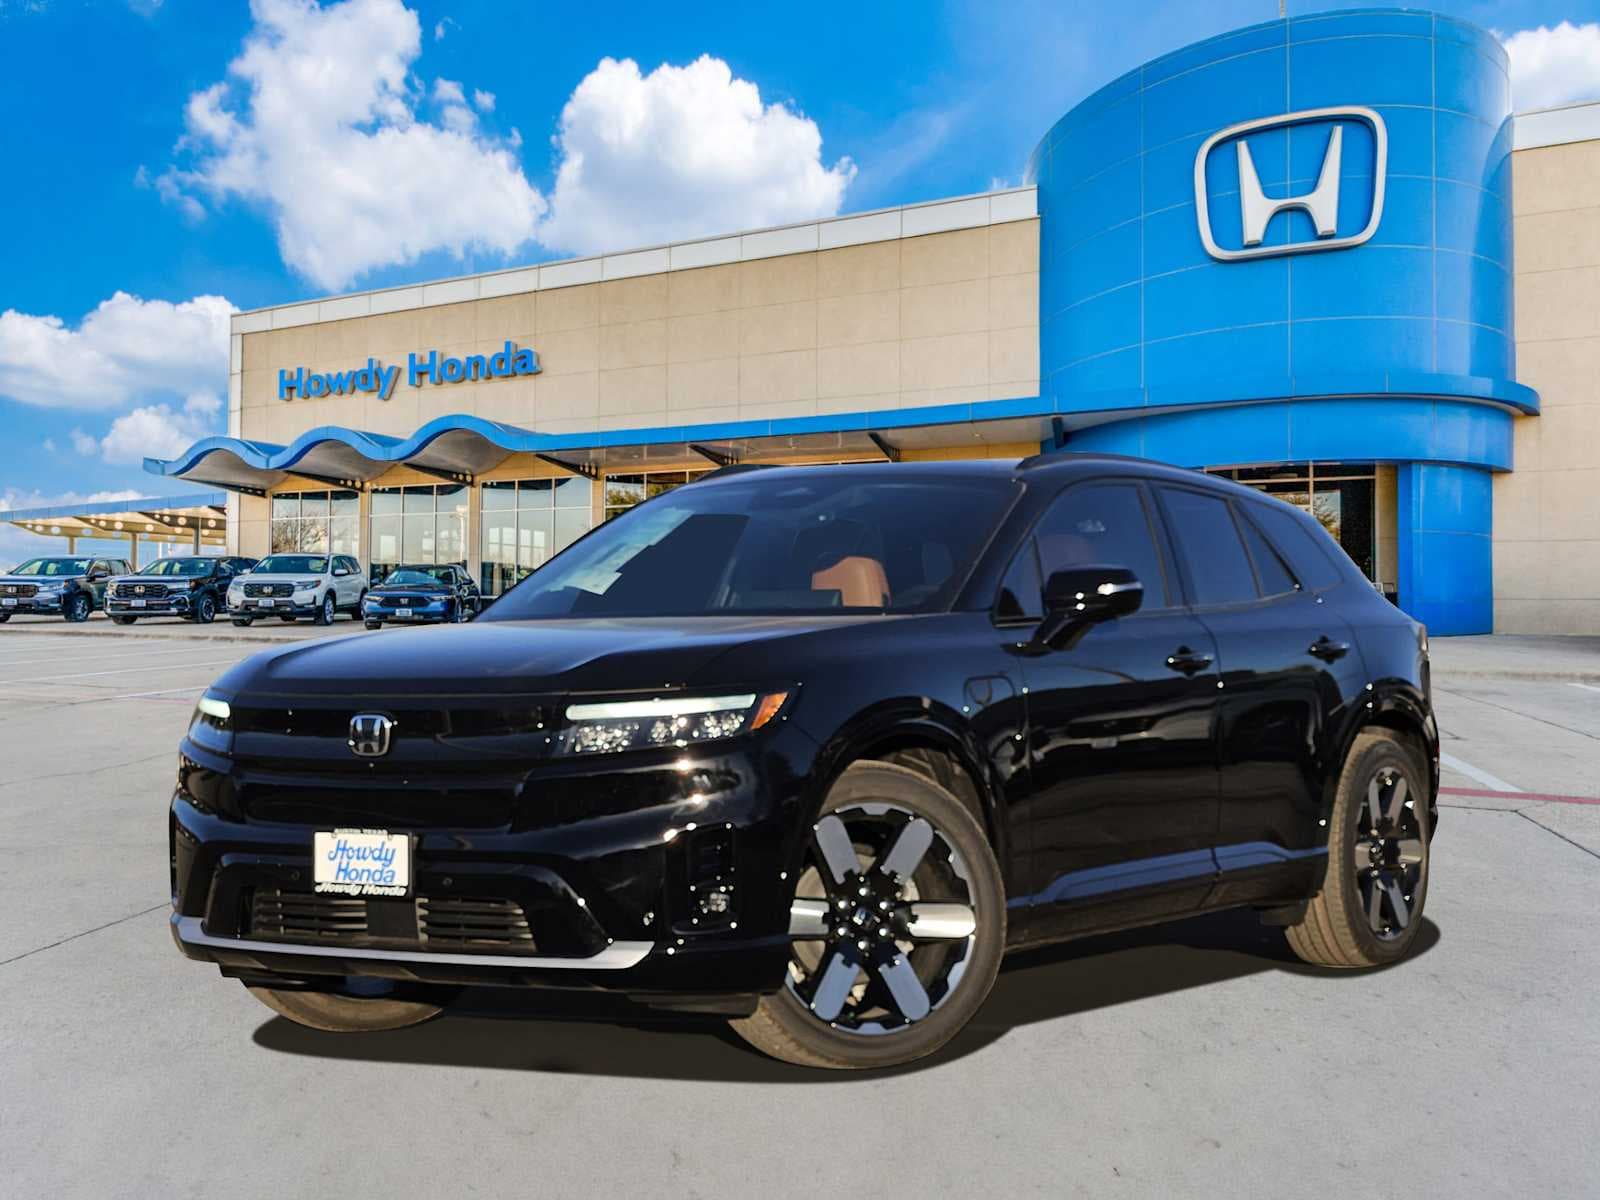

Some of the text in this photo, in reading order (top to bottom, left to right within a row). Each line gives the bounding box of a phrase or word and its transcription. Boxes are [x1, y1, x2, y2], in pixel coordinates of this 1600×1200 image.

[278, 340, 542, 401] Howdy Honda
[328, 839, 397, 867] Howdy
[335, 861, 396, 883] Honda
